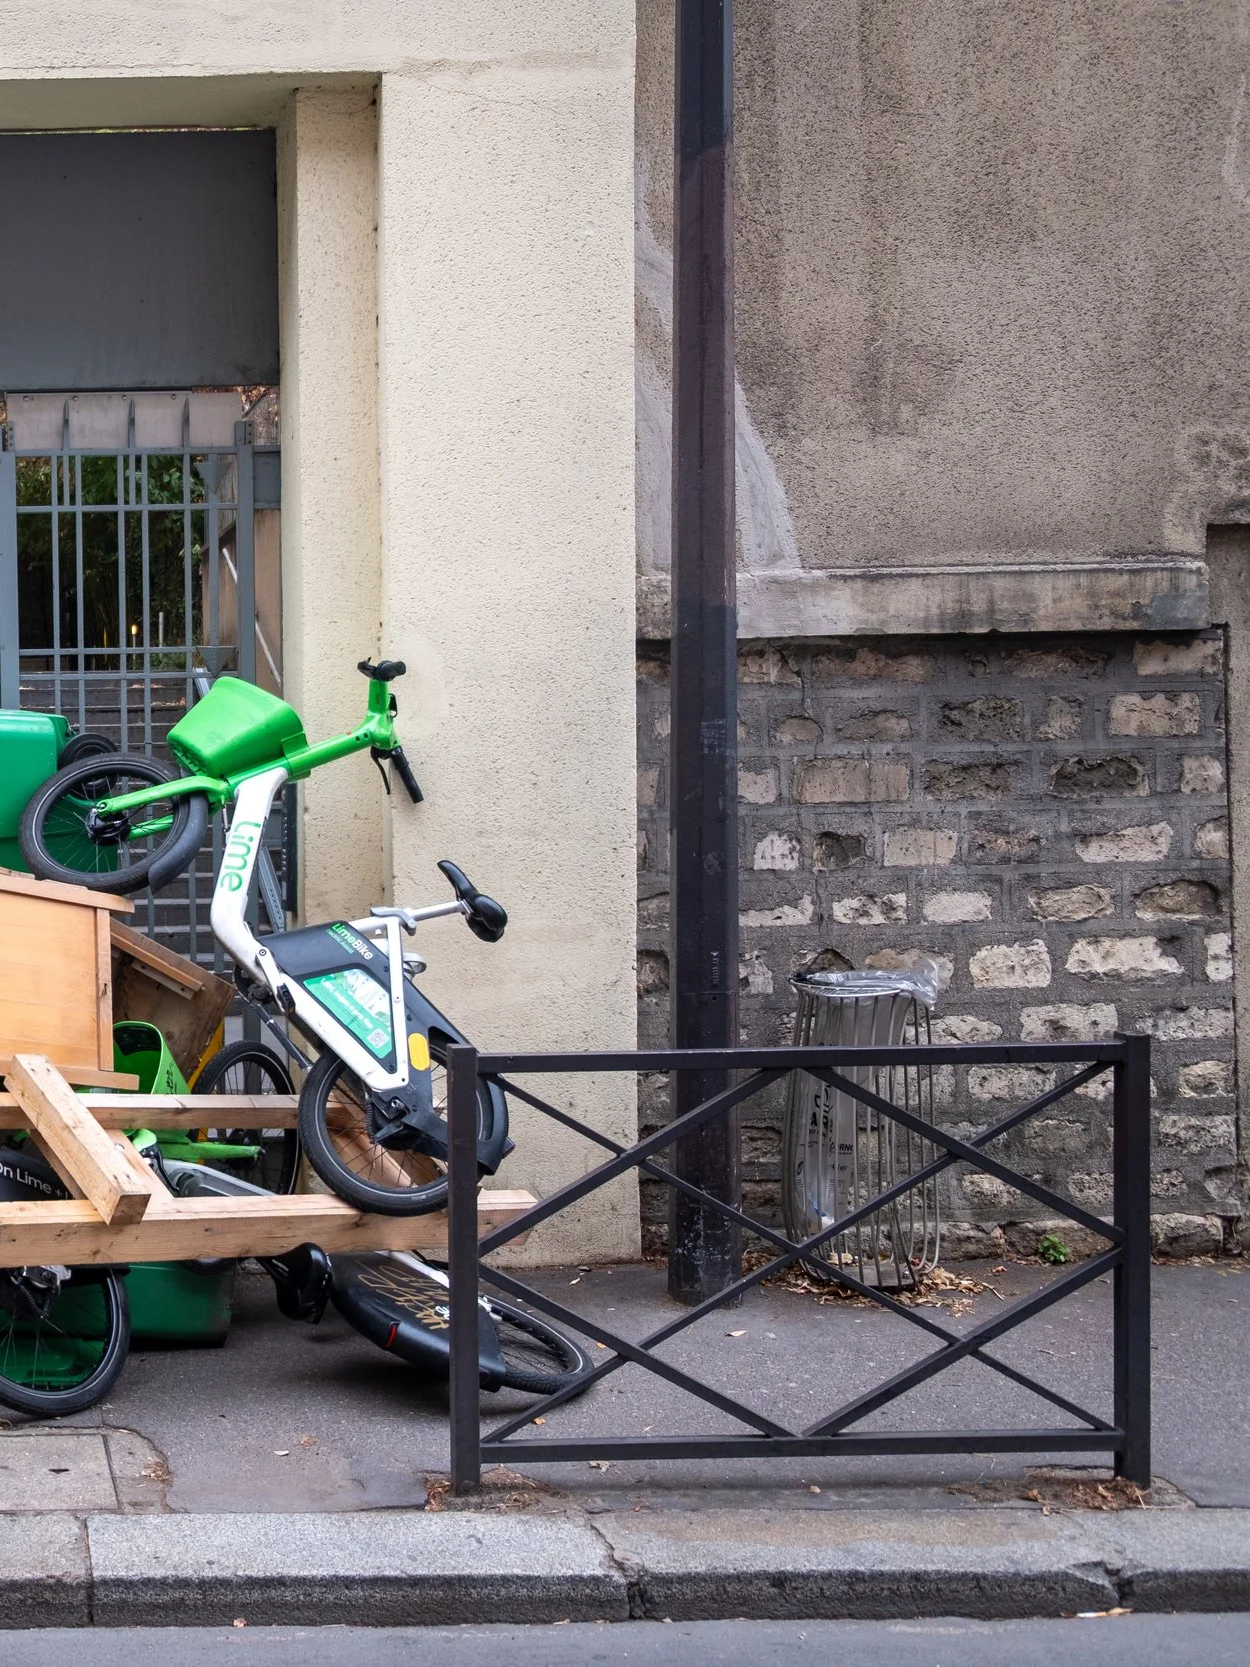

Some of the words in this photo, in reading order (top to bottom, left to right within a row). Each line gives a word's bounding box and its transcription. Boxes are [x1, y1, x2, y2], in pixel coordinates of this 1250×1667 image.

[220, 820, 261, 892] Lime
[332, 922, 374, 960] LimeBike
[16, 1167, 52, 1194] Lime
